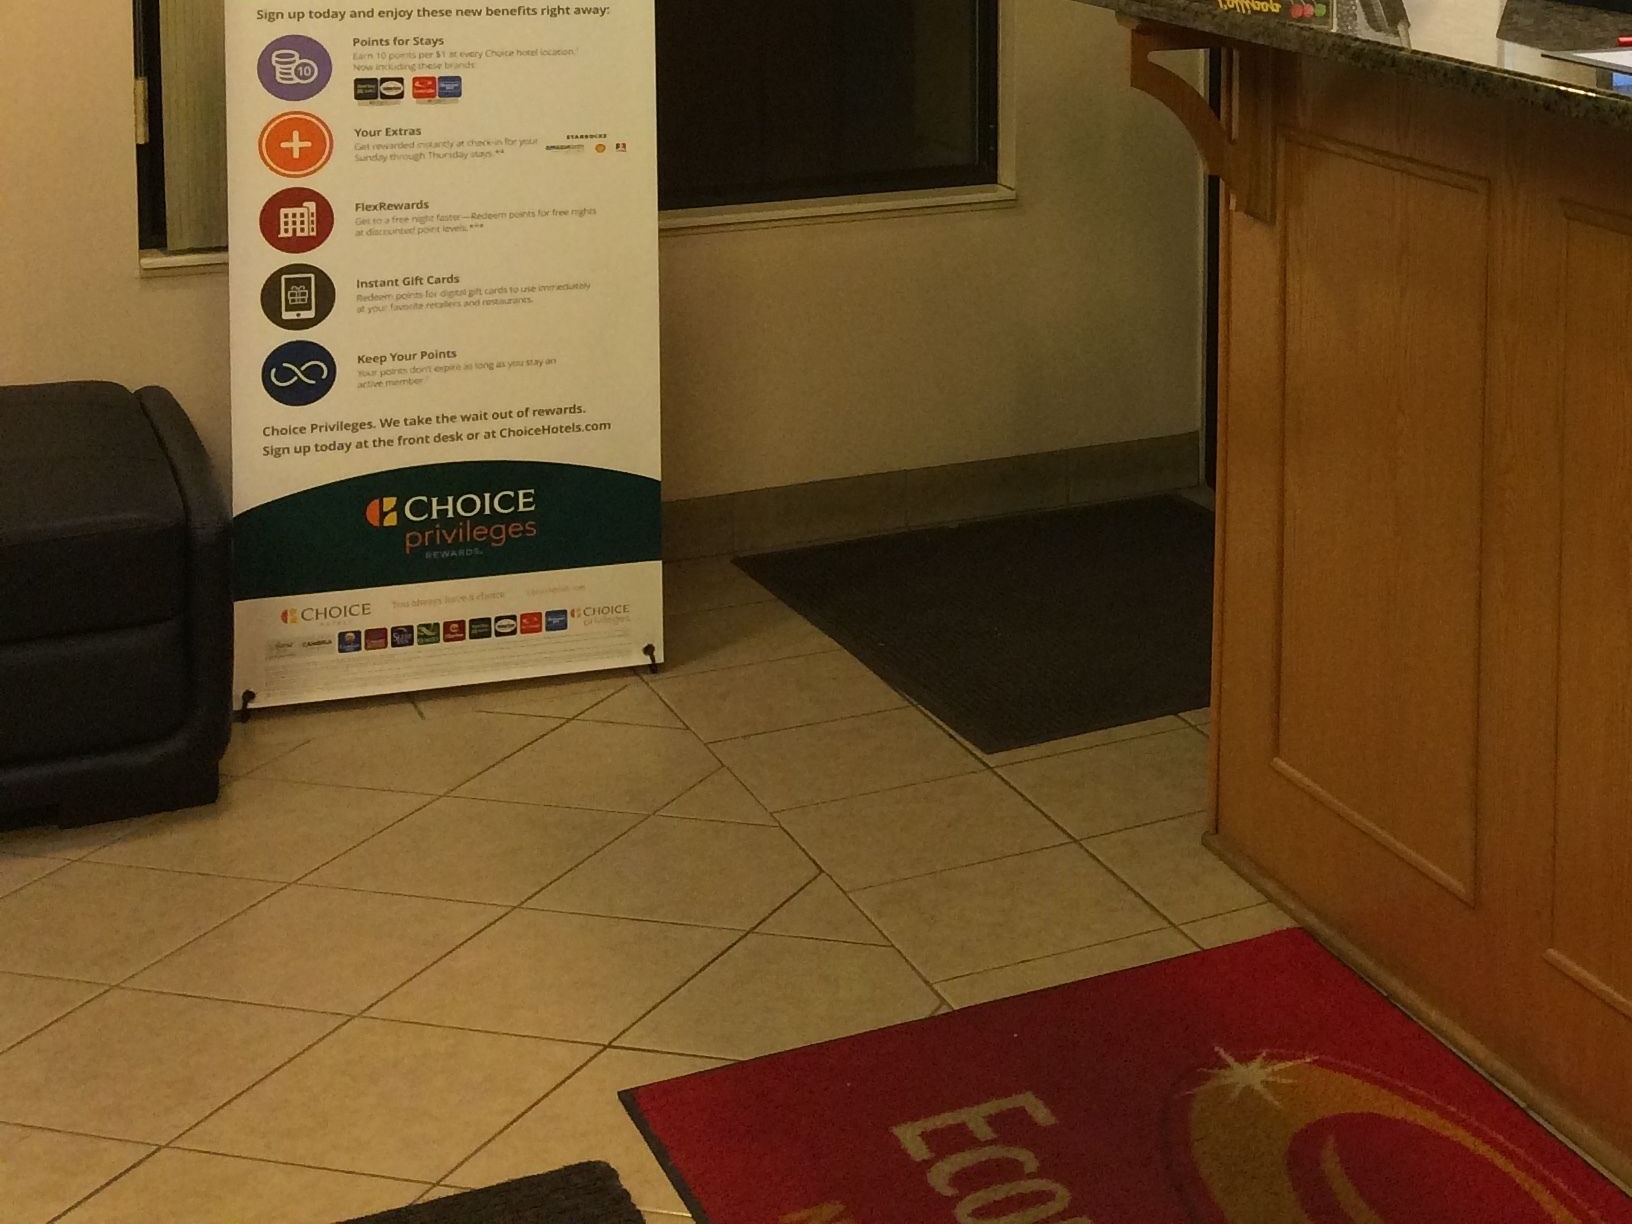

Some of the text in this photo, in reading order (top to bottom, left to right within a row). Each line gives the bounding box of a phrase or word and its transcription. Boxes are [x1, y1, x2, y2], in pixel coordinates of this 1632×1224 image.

[257, 3, 609, 22] Sign up today and enjoy these new benefits right away:
[353, 35, 445, 49] Points for Stays
[297, 65, 312, 77] 10
[354, 125, 421, 139] Your Extras
[355, 199, 432, 213] FlexRewards
[357, 273, 459, 289] Instant Gift Cards
[358, 348, 457, 365] Keep Your Points
[262, 403, 585, 437] Choice Privileges. We take the wait out of rewards.
[263, 420, 611, 458] Sign up today at the front desk or at ChoiceHotels.com
[404, 489, 536, 521] CHOICE
[405, 519, 537, 554] privileges
[301, 602, 372, 622] CHOICE
[583, 603, 630, 618] CHOICE
[892, 1091, 1096, 1224] ECO
